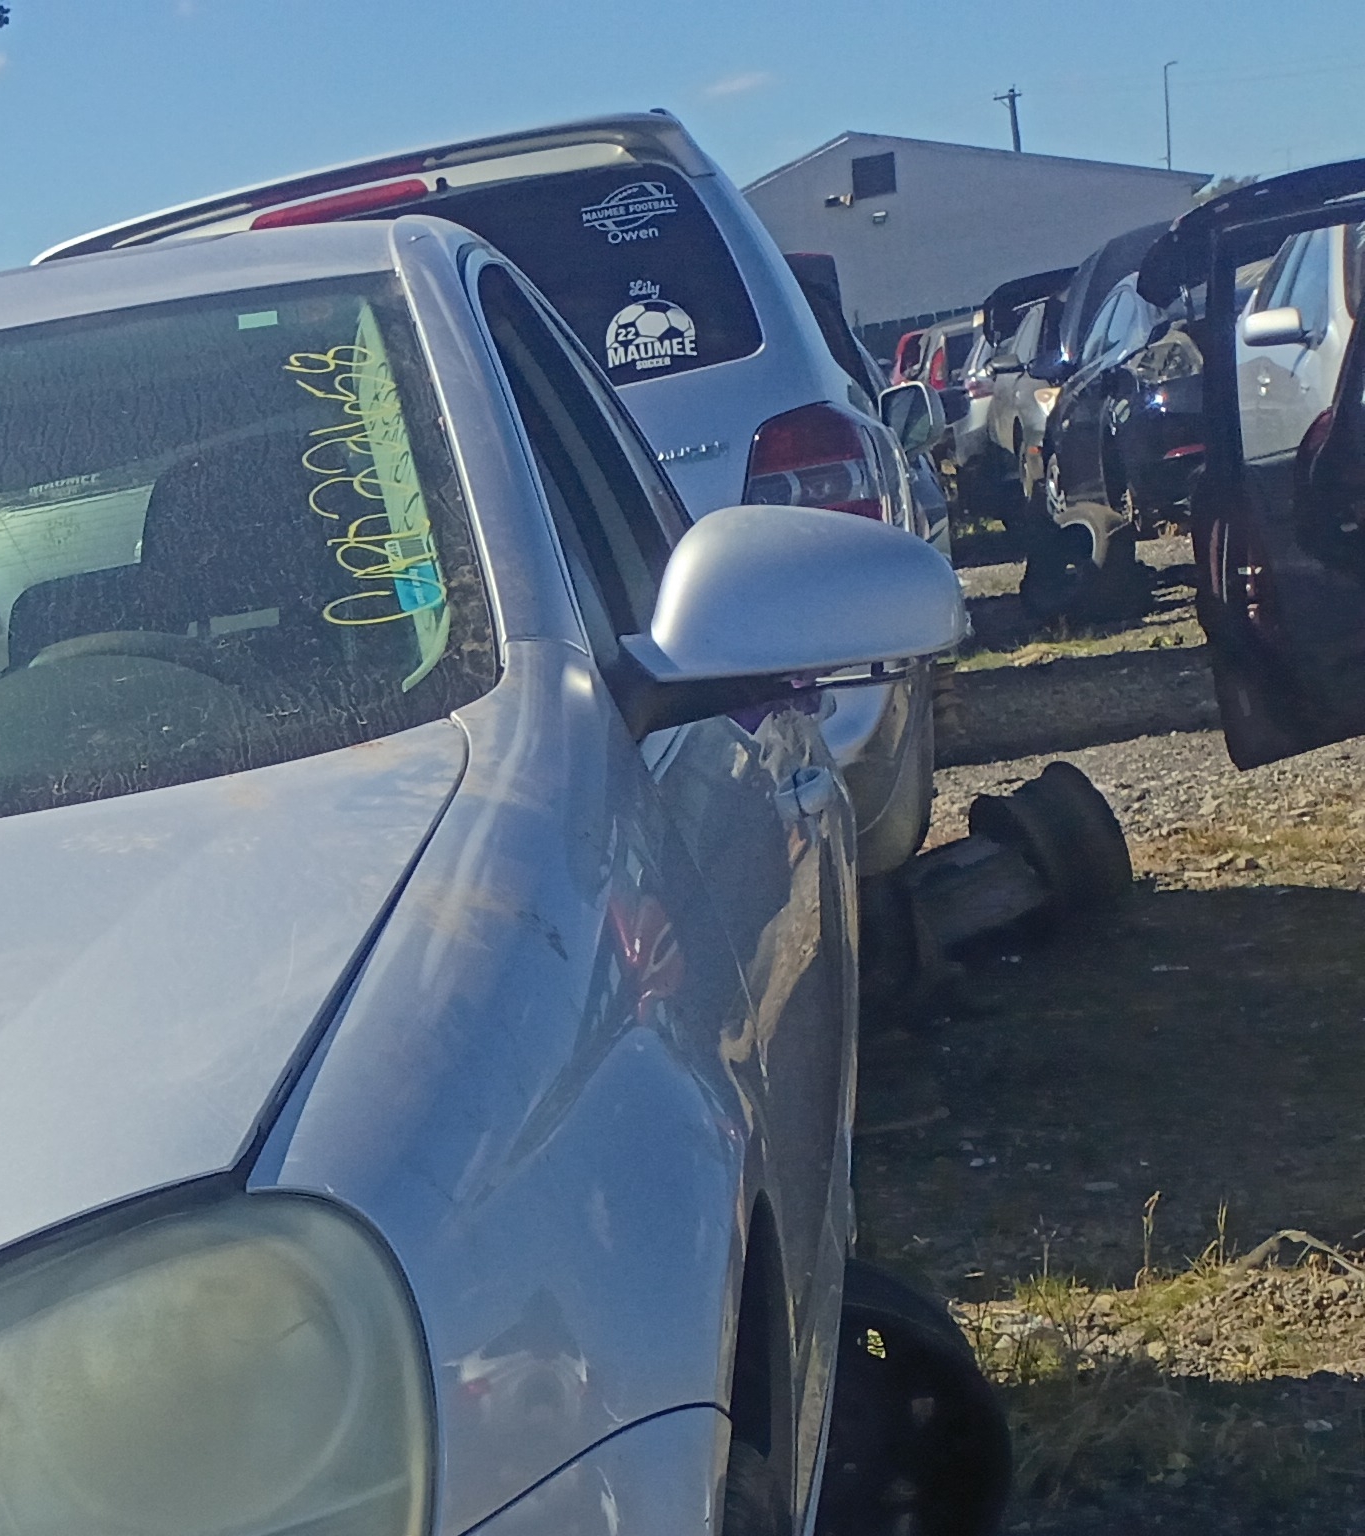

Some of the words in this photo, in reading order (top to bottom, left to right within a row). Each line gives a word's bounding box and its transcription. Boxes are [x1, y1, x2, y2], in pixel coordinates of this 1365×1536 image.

[582, 205, 627, 222] MAUMEE
[628, 199, 679, 214] FOOTBALL
[607, 227, 659, 244] Owen
[617, 327, 636, 342] 22
[607, 337, 698, 369] MAUMEE
